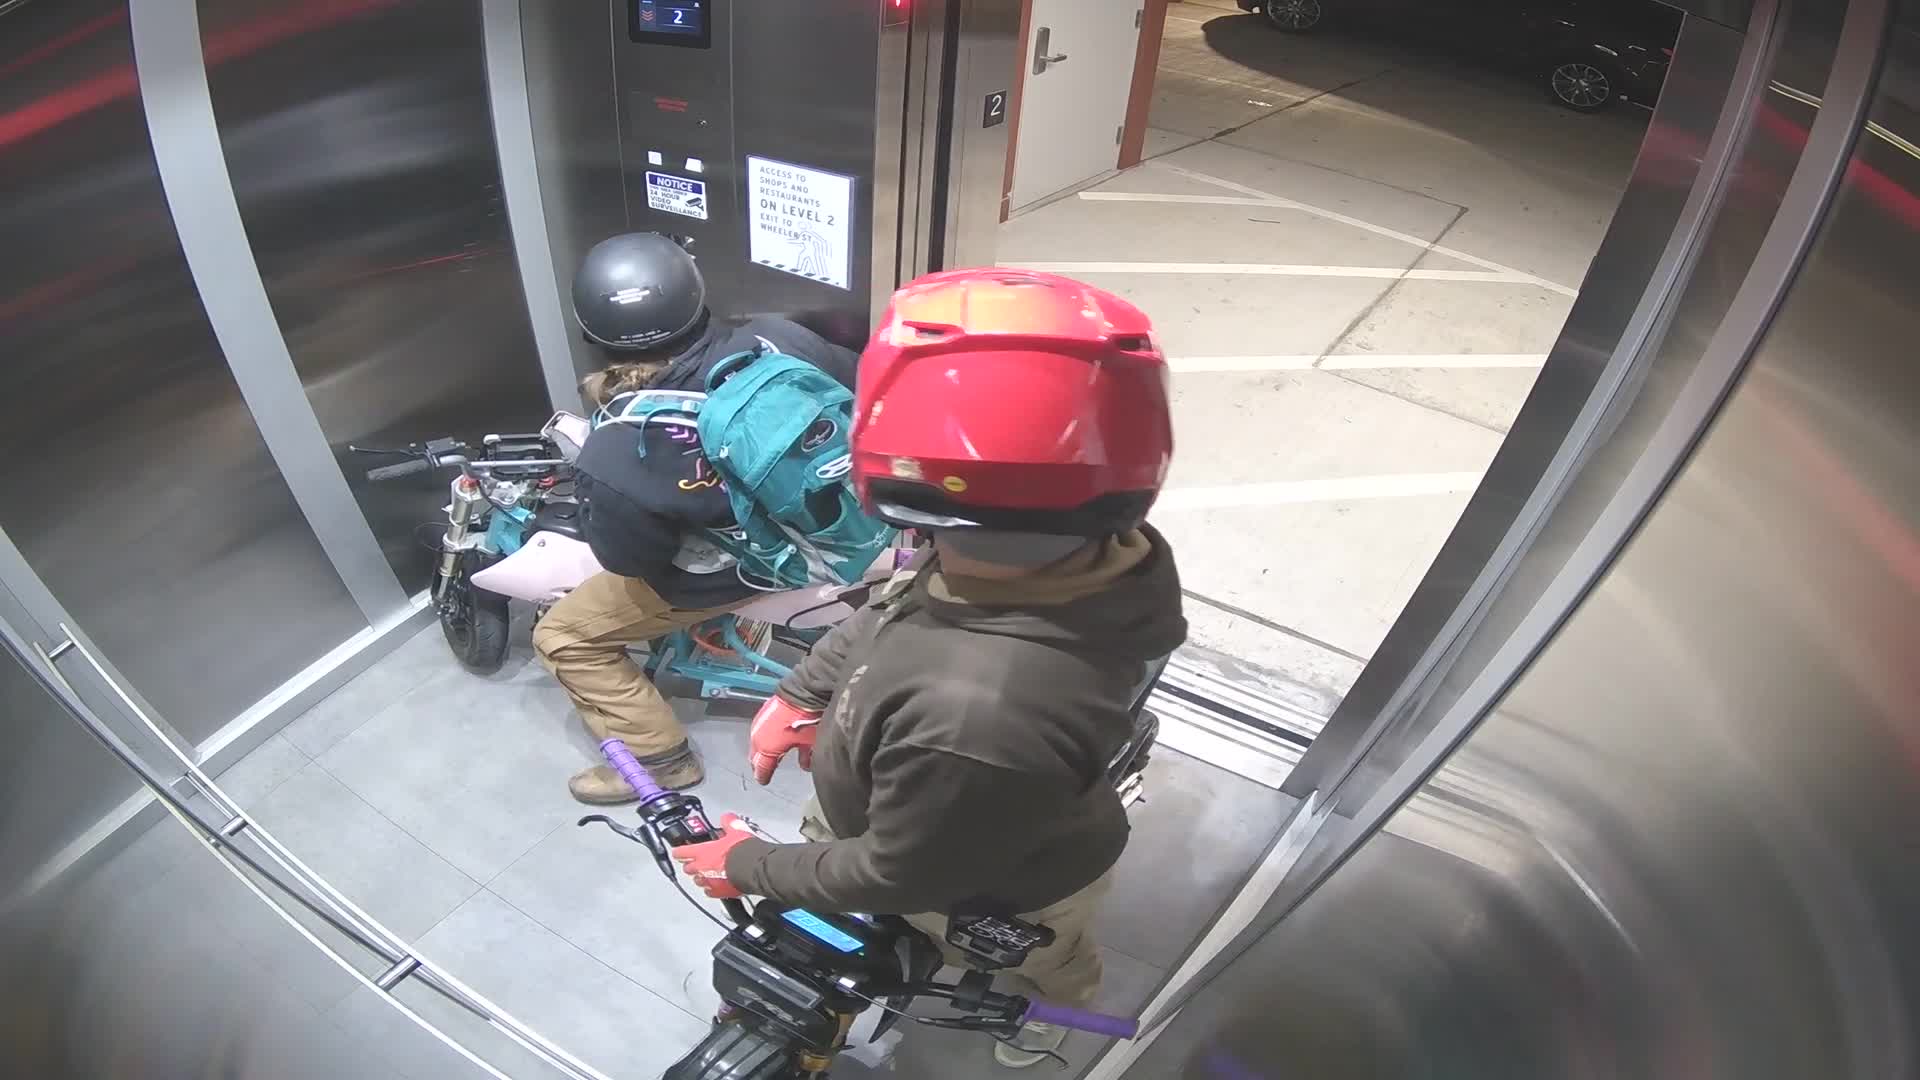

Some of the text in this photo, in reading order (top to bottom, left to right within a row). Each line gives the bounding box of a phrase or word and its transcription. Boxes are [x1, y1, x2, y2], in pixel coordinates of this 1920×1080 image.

[673, 10, 683, 24] 2
[990, 94, 1002, 117] 2
[760, 166, 806, 182] ACCESS TO
[656, 177, 693, 192] NOTICE
[760, 176, 809, 194] SHOPS AND
[650, 196, 672, 205] VIDEO
[661, 192, 680, 200] HOUR
[760, 186, 821, 207] RESTAURANTS
[760, 199, 835, 226] ON LEVEL 2
[760, 212, 792, 227] EXIT TO
[760, 222, 812, 242] WHEELER ST
